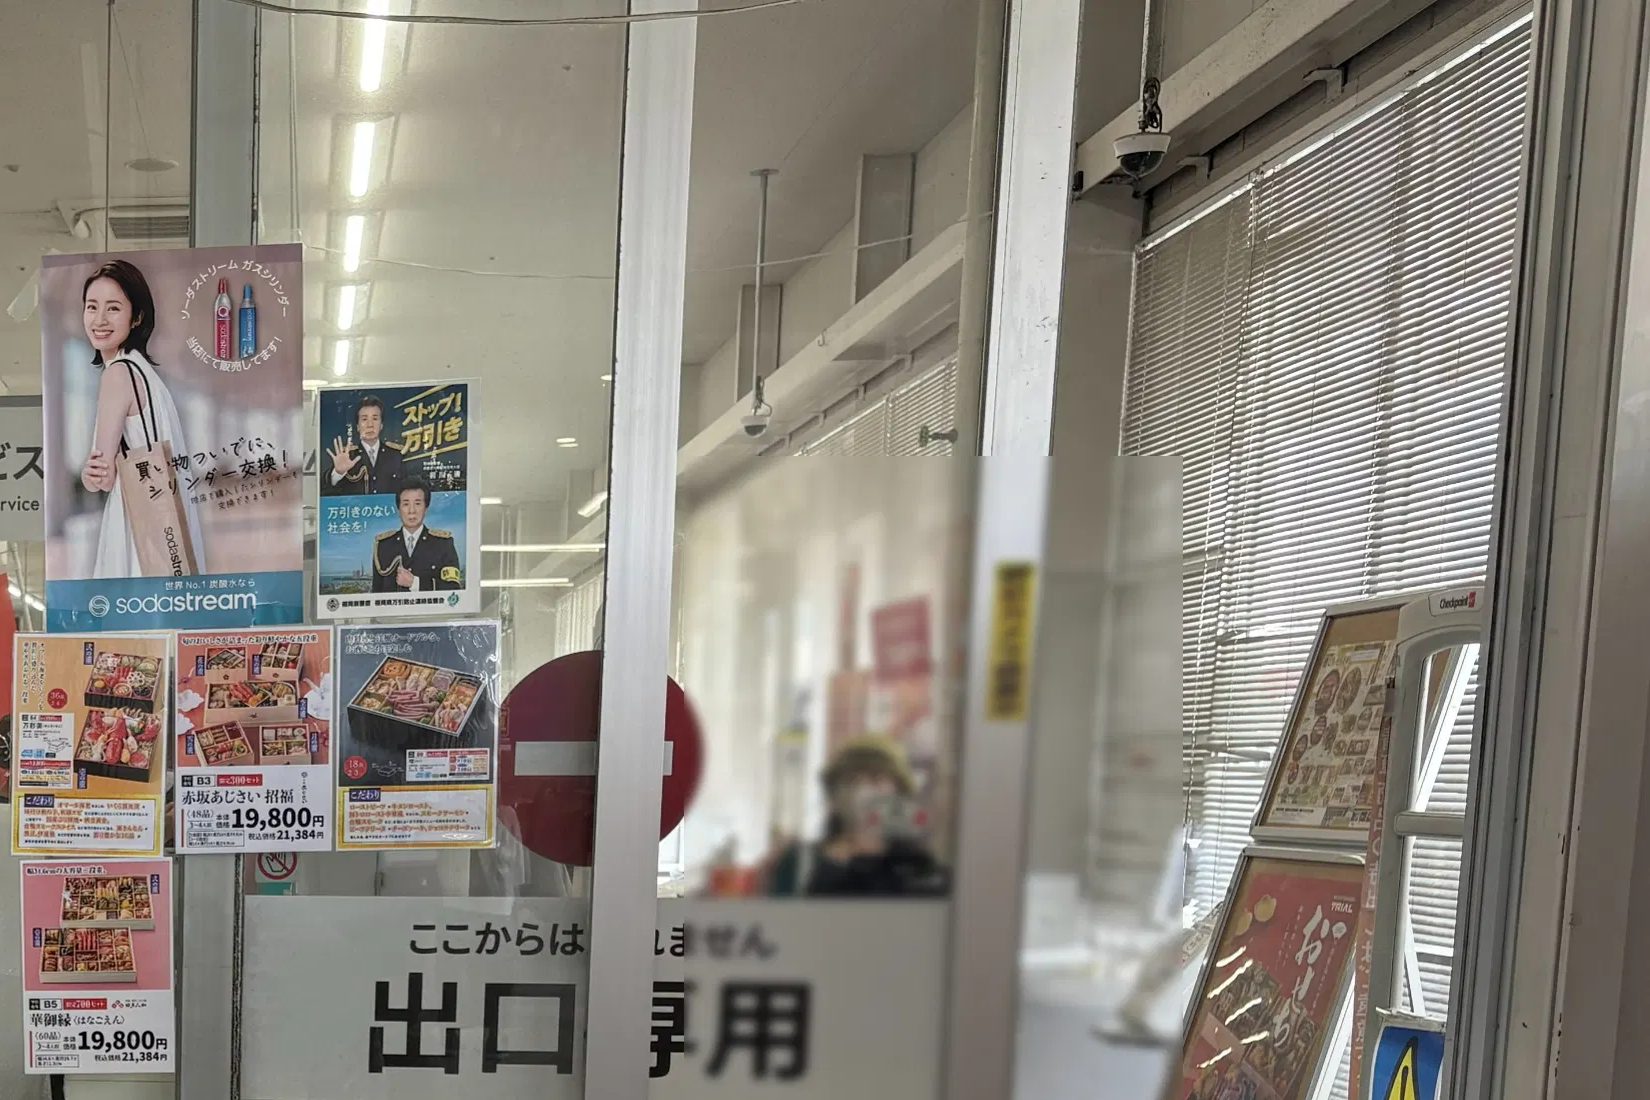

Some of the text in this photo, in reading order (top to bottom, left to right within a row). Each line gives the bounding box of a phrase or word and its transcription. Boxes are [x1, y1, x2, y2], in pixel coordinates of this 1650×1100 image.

[181, 260, 289, 320] ソーダストリーム ガスシリンダー
[401, 417, 463, 455] 万引き
[135, 437, 274, 482] 買い物ついでに、
[327, 505, 396, 519] 万引きのない
[327, 522, 367, 534] 社会を!
[165, 581, 184, 591] 世界
[209, 579, 256, 589] 炭酸水なら
[116, 592, 258, 614] sodastream
[197, 777, 211, 785] B3
[26, 795, 53, 805] こだわり
[182, 789, 294, 805] 赤坂あじさい 招福
[350, 790, 380, 800] こだわり
[232, 807, 324, 831] 19,800円
[1331, 902, 1352, 913] TRIAL
[44, 1000, 58, 1008] B5
[78, 1030, 167, 1053] 19,800円
